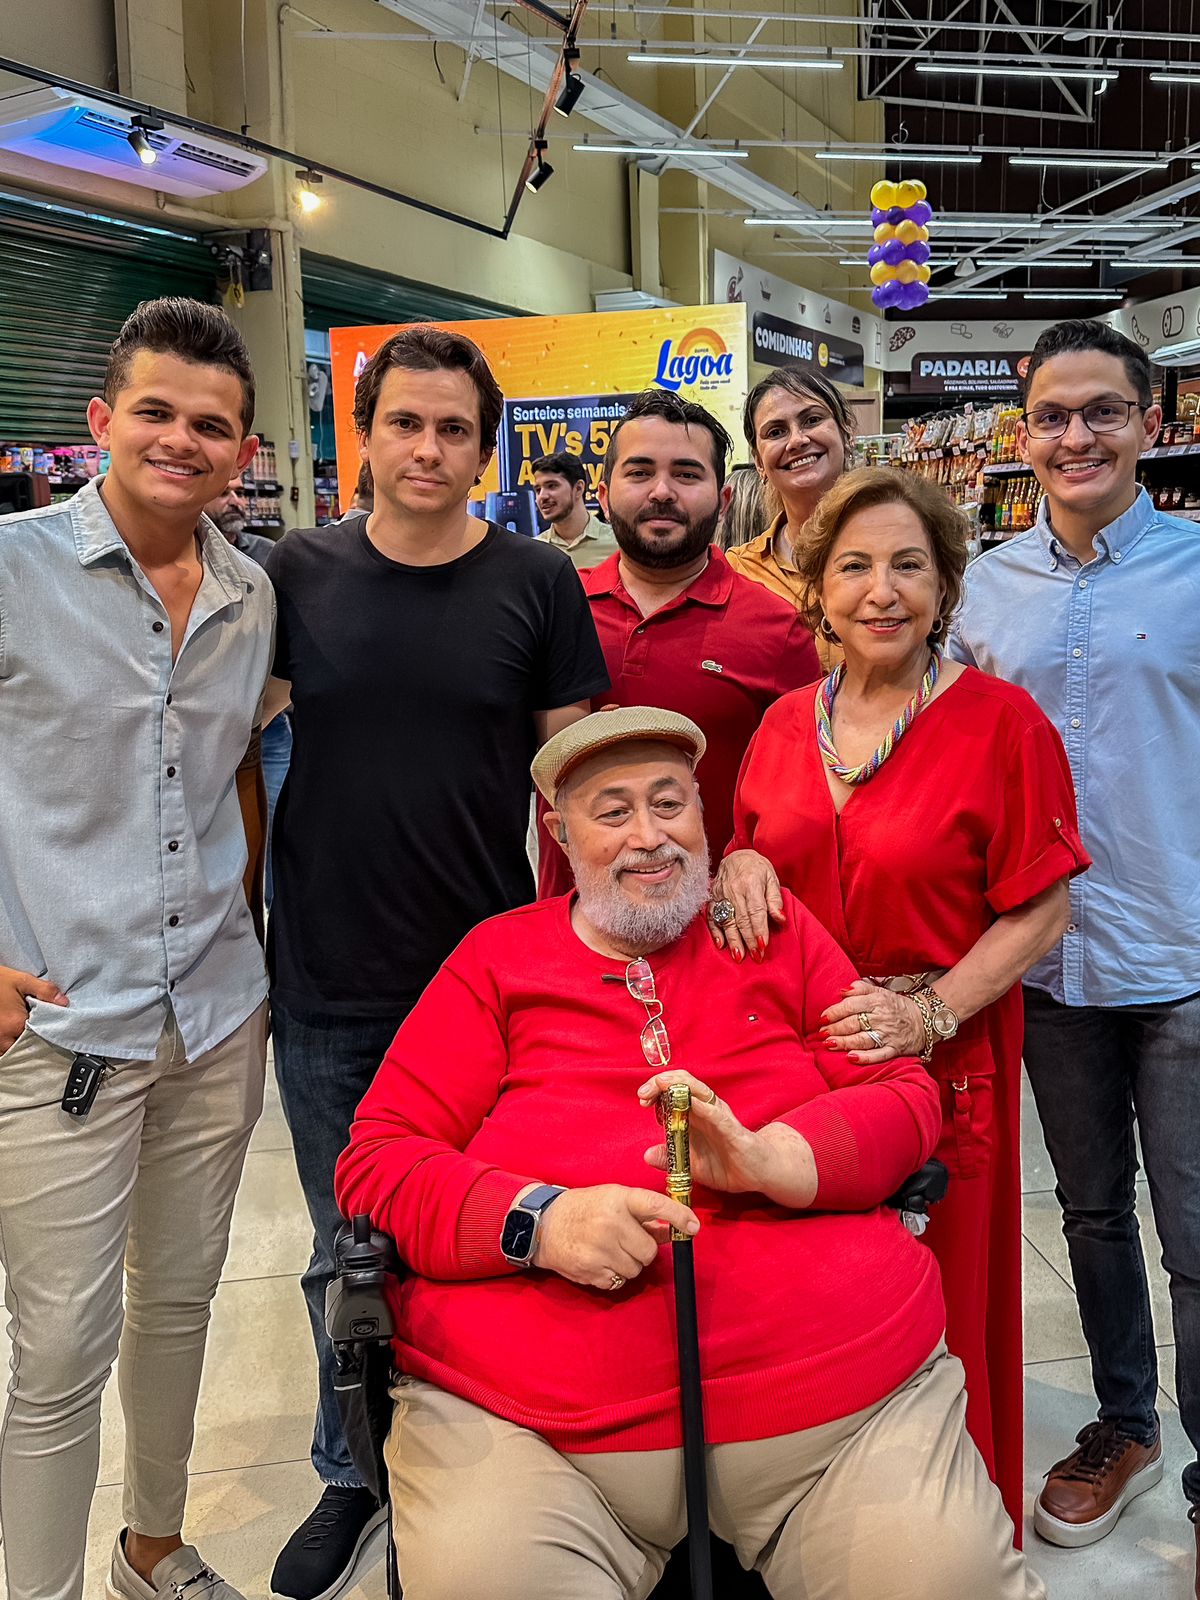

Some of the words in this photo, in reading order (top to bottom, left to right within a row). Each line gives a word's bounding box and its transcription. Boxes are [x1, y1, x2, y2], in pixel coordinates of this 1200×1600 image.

[755, 327, 813, 361] COMIDINHAS
[652, 339, 733, 391] Lagoa
[920, 360, 1012, 377] PADARIA
[513, 406, 566, 421] Sorteios
[567, 402, 627, 419] semanais
[514, 422, 584, 457] TV's
